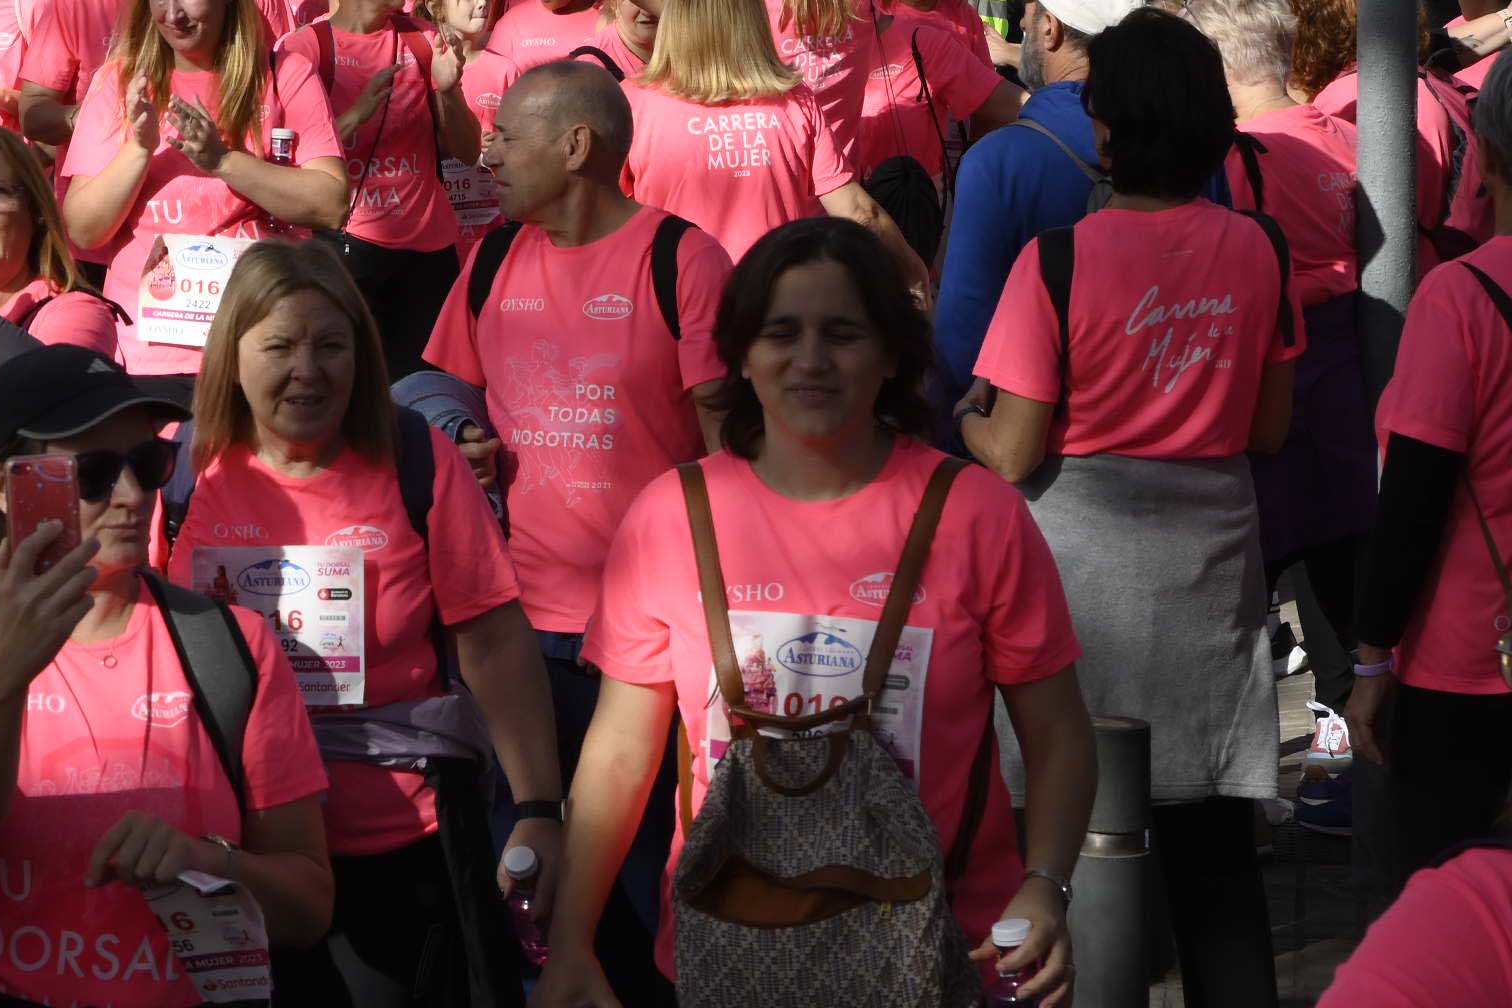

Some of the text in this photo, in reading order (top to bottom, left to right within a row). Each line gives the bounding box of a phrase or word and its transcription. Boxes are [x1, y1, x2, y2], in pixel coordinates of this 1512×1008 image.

[520, 38, 556, 48] OYSHO
[781, 30, 853, 54] CARRERA
[795, 52, 816, 69] DE
[687, 112, 782, 135] CARRERA
[707, 131, 768, 151] DE LA
[348, 154, 420, 180] ORSAL
[707, 150, 770, 170] MUJER
[443, 179, 471, 193] 016
[147, 199, 183, 224] TU
[180, 278, 220, 295] 016
[185, 299, 211, 310] 2422
[500, 296, 544, 312] OYSHO
[586, 303, 630, 316] ASTURIANA
[1125, 285, 1239, 336] Carrera
[1142, 334, 1217, 394] Mujer
[574, 384, 616, 401] POR
[548, 406, 616, 426] TODAS
[510, 429, 615, 450] NOSOTRAS
[240, 565, 307, 588] ASTURIANA
[318, 567, 351, 576] SUMA
[783, 646, 856, 669] ASTURIANA
[299, 680, 350, 694] Santander
[199, 954, 234, 969] MUJER
